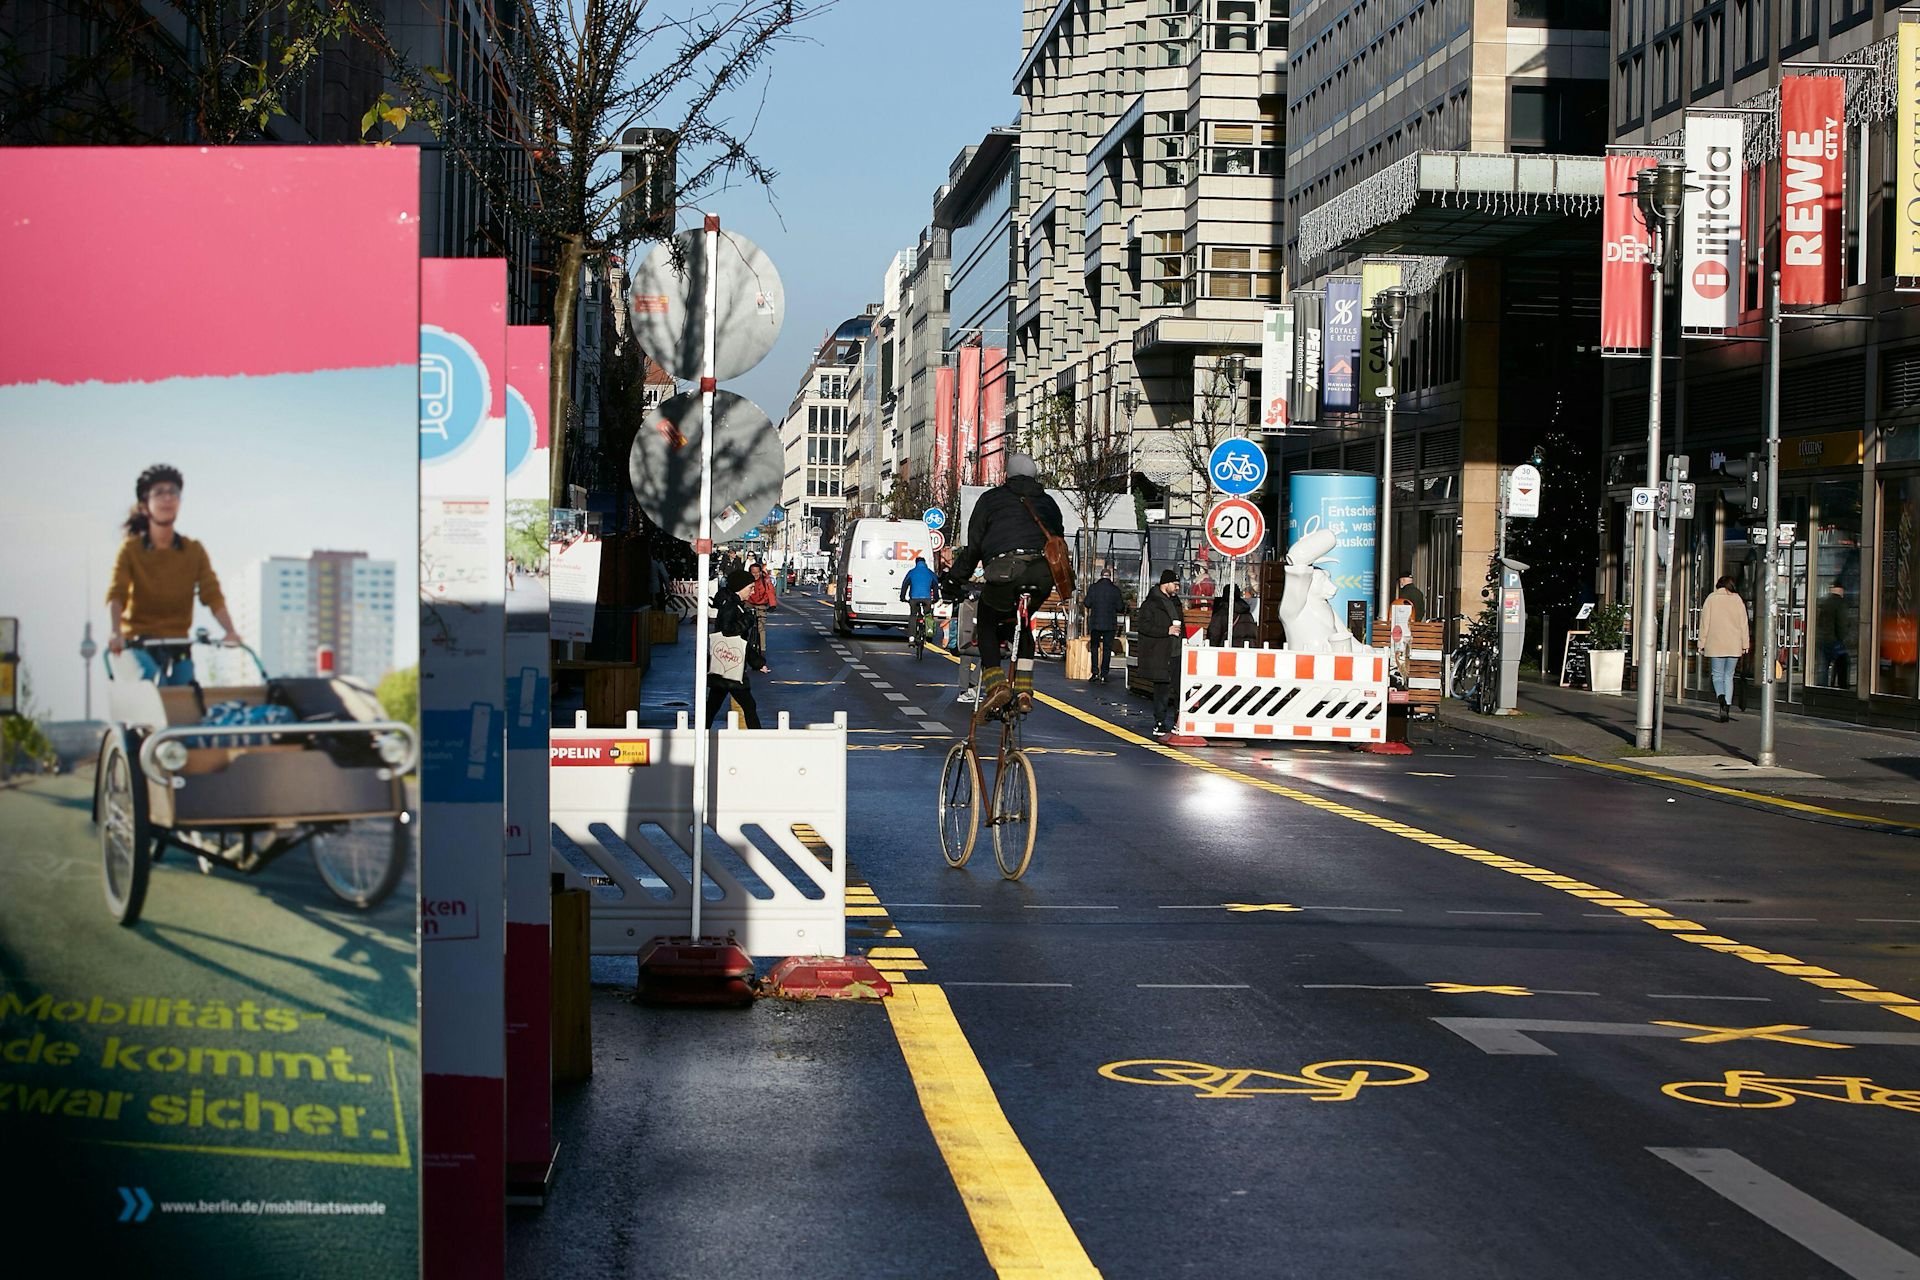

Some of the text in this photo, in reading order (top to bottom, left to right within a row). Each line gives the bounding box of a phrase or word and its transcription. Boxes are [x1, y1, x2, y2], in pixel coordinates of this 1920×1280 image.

[1825, 117, 1838, 160] CITY
[1697, 146, 1731, 255] iittala
[1786, 129, 1823, 265] REWE
[1220, 515, 1250, 539] 20
[1352, 522, 1373, 532] was
[1508, 573, 1518, 587] P
[0, 992, 326, 1033] Mobilitäts-
[102, 1037, 373, 1083] kommt.
[147, 1089, 389, 1140] sicher.
[161, 1199, 386, 1216] www.berlin.de/mobilitaetswende
